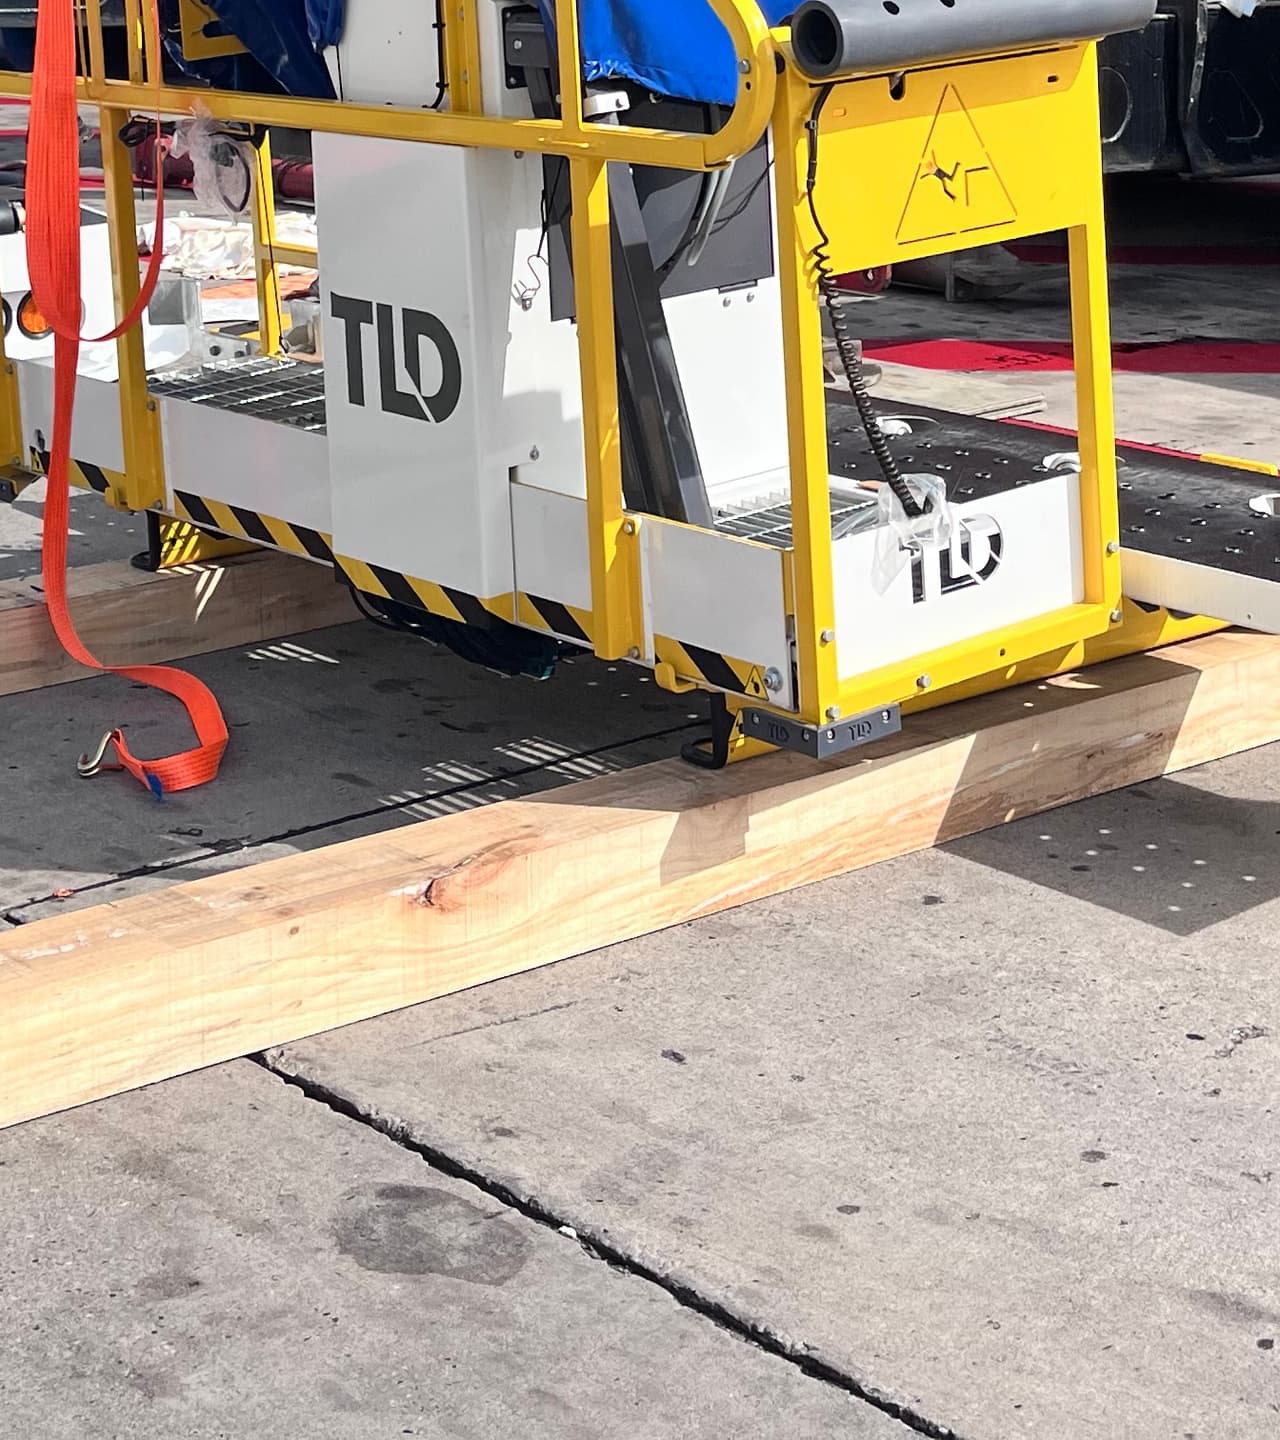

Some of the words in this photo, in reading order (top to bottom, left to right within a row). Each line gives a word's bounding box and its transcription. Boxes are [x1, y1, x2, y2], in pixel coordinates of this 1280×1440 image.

[330, 291, 462, 424] TLD
[899, 513, 1004, 604] TLD
[848, 720, 872, 741] TLD
